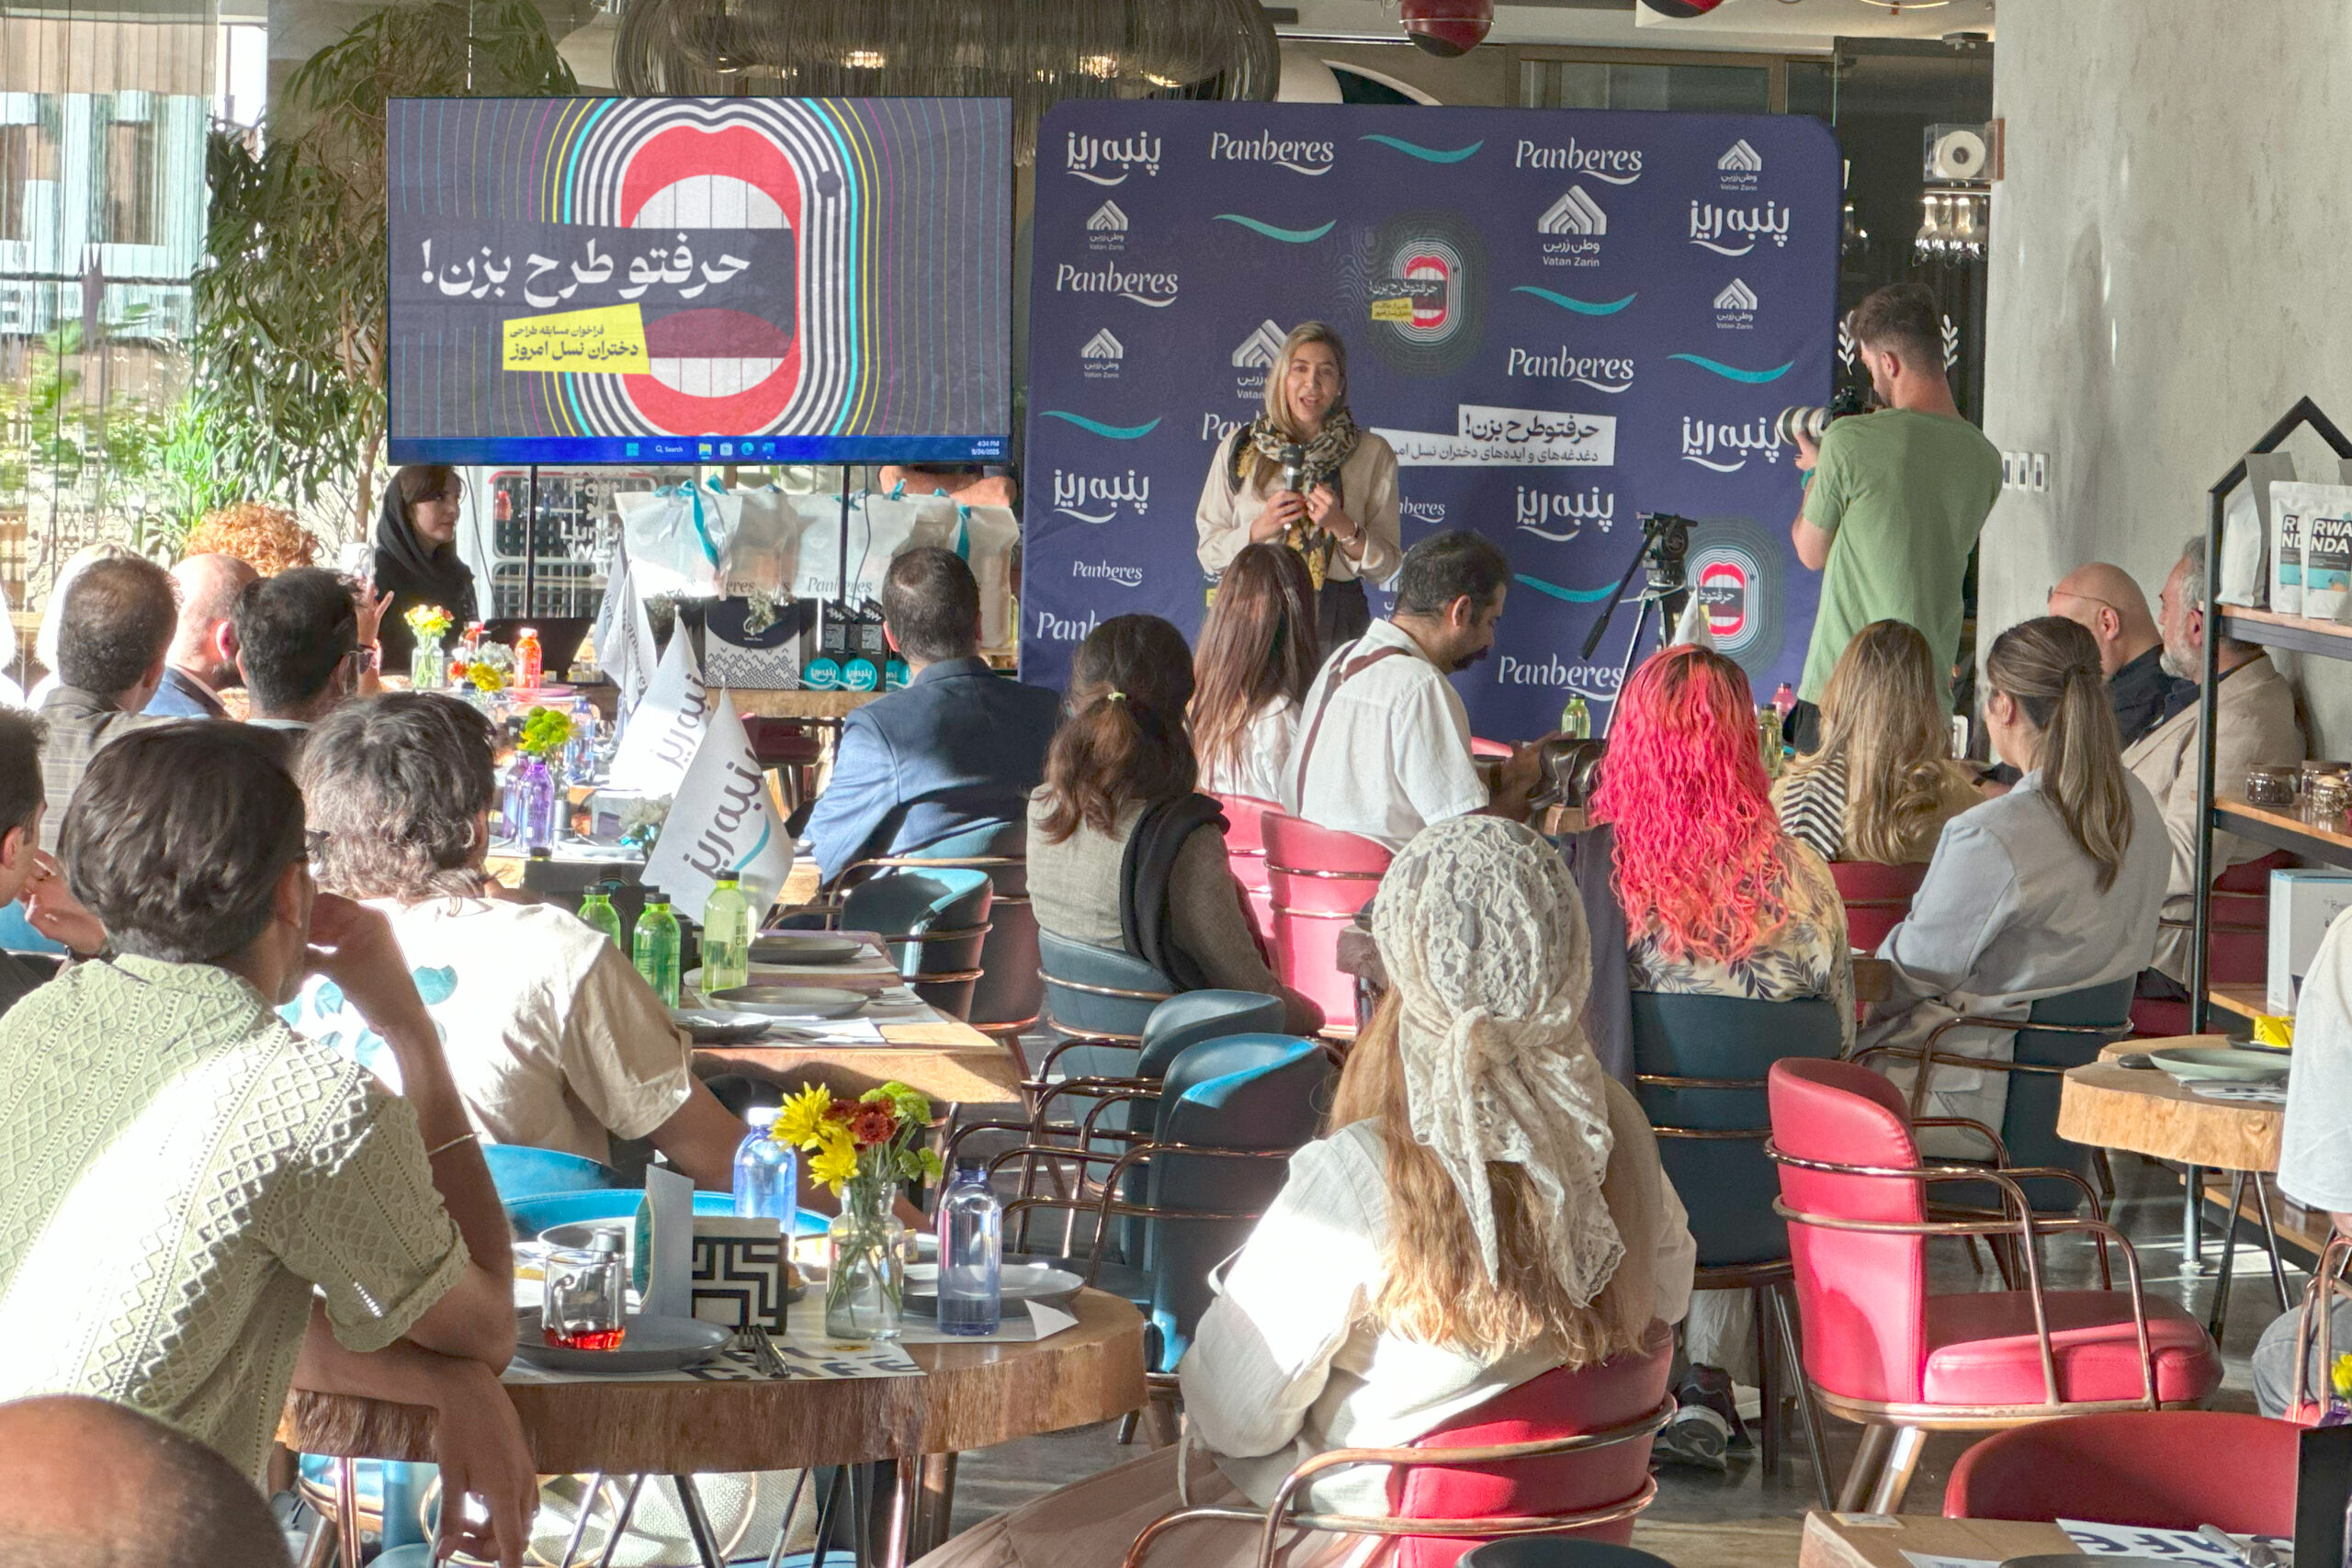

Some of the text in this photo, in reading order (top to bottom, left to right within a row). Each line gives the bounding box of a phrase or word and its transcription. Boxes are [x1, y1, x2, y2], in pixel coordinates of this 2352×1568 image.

[1211, 130, 1334, 163] Panberes
[1515, 137, 1642, 171] Panberes
[1544, 239, 1600, 254] وطن زرین
[422, 231, 751, 308] حرفتو طرح بزن!
[1543, 256, 1600, 266] Vatan Zarin
[1056, 261, 1179, 294] Panberes
[509, 324, 605, 338] فراخوان مسابقه طراحی
[509, 341, 639, 361] دختران نسل امروز
[1508, 345, 1634, 379] Panberes
[1237, 389, 1265, 399] Vatan
[1465, 413, 1600, 445] حرفتو طرح بزن!
[1410, 443, 1437, 460] نسل
[1439, 445, 1477, 460] دختران
[1526, 453, 1535, 463] و
[1399, 497, 1445, 516] beres
[2312, 520, 2352, 537] RWA
[2311, 536, 2350, 554] NDA
[1073, 560, 1143, 580] Panberes
[725, 581, 756, 592] eres
[808, 576, 873, 592] Paneres
[1498, 654, 1623, 688] Panberes
